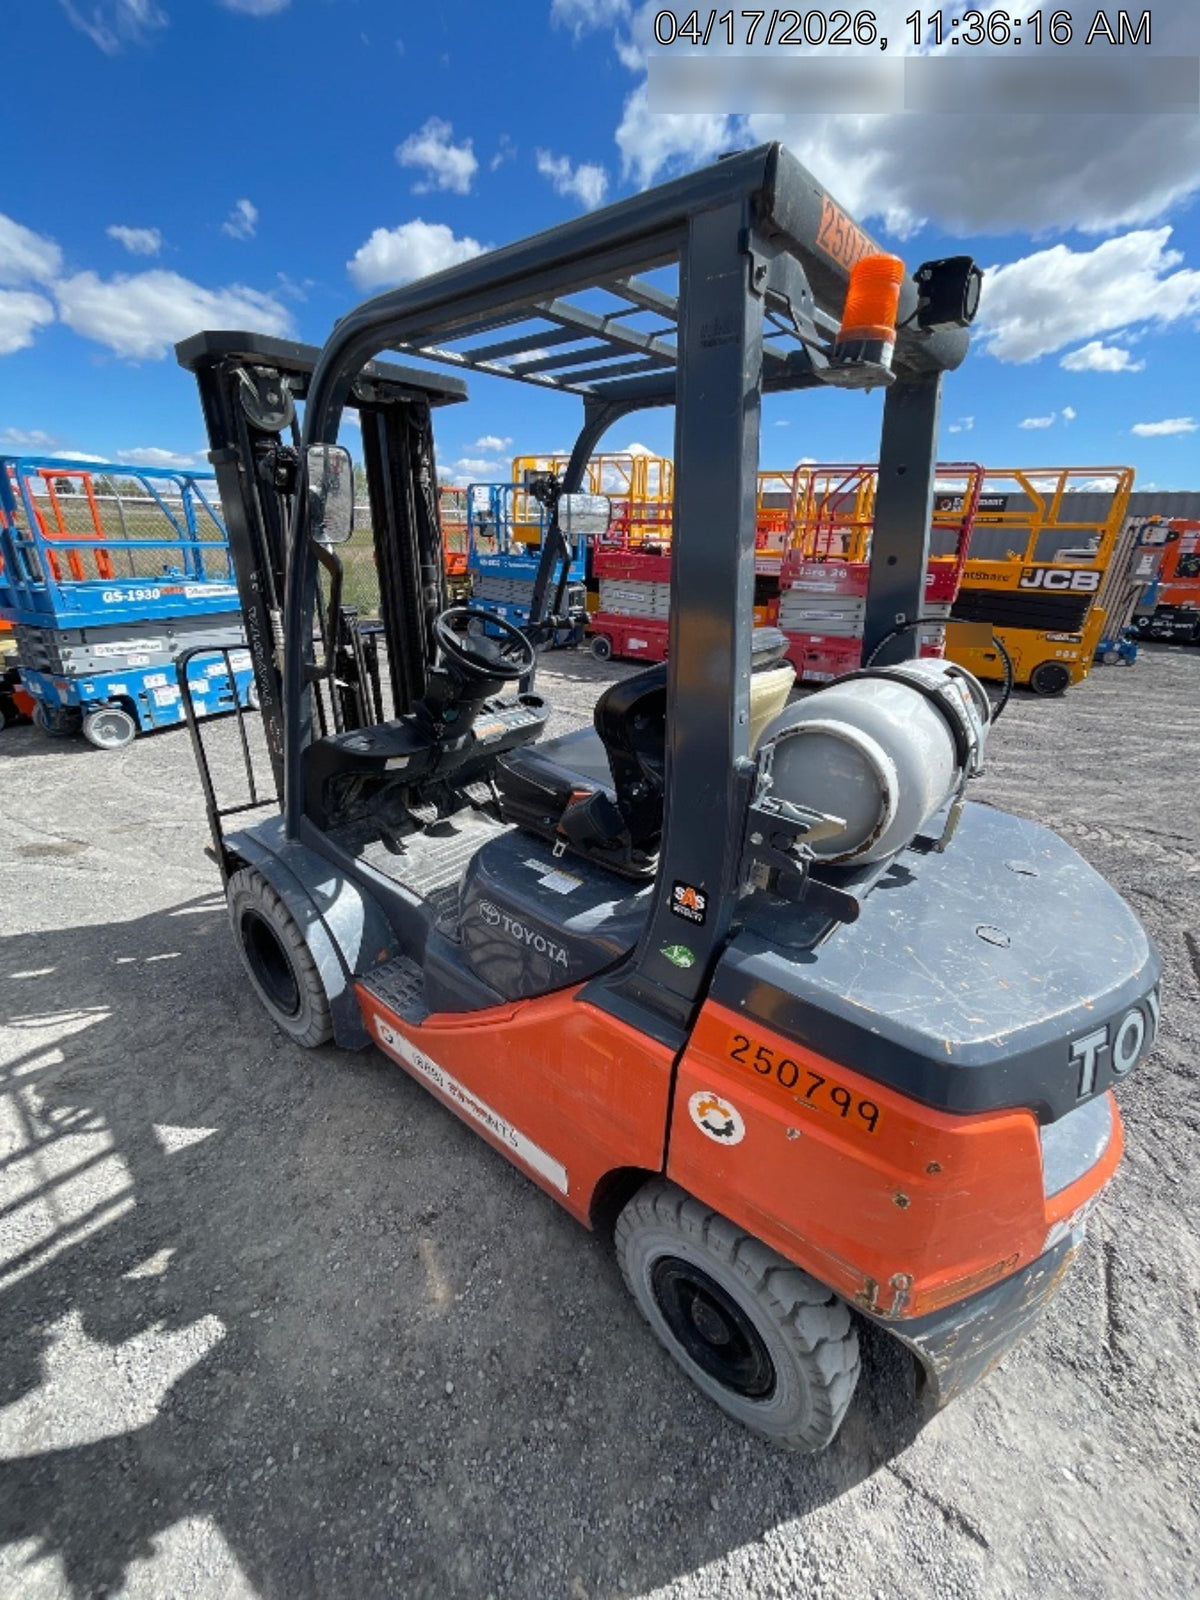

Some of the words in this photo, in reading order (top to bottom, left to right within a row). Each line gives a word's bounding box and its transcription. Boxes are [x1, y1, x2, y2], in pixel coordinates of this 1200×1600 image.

[1020, 569, 1100, 590] JCB
[103, 588, 161, 603] GS-1930
[674, 886, 705, 911] SAS
[502, 914, 568, 968] TOYOTA
[730, 1034, 880, 1133] 250799
